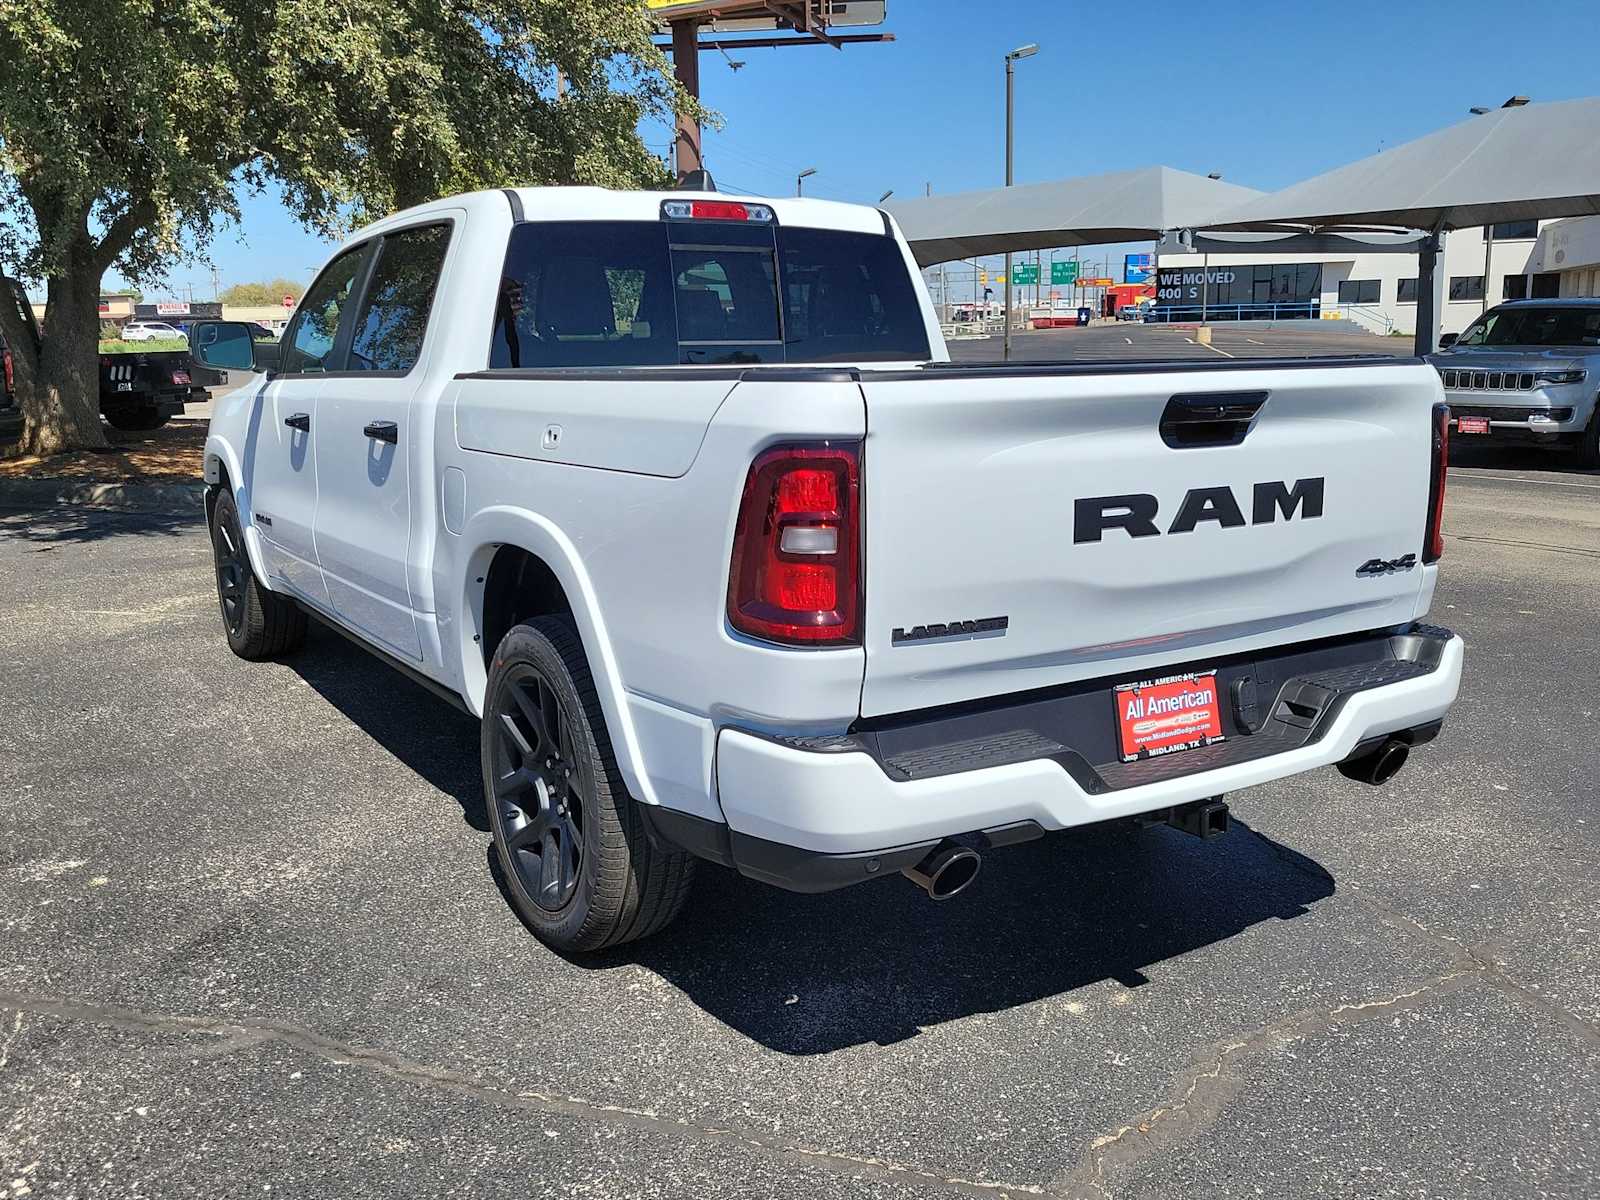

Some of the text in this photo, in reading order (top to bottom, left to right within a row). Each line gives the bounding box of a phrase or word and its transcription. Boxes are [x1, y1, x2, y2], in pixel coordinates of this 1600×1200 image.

[1160, 271, 1236, 286] WE MOVED
[1158, 287, 1198, 299] 400 S
[1074, 477, 1325, 544] RAM
[1139, 679, 1153, 689] ALL
[1125, 690, 1212, 720] All American
[1148, 743, 1188, 757] MIDLAND,
[1188, 740, 1201, 748] TX
